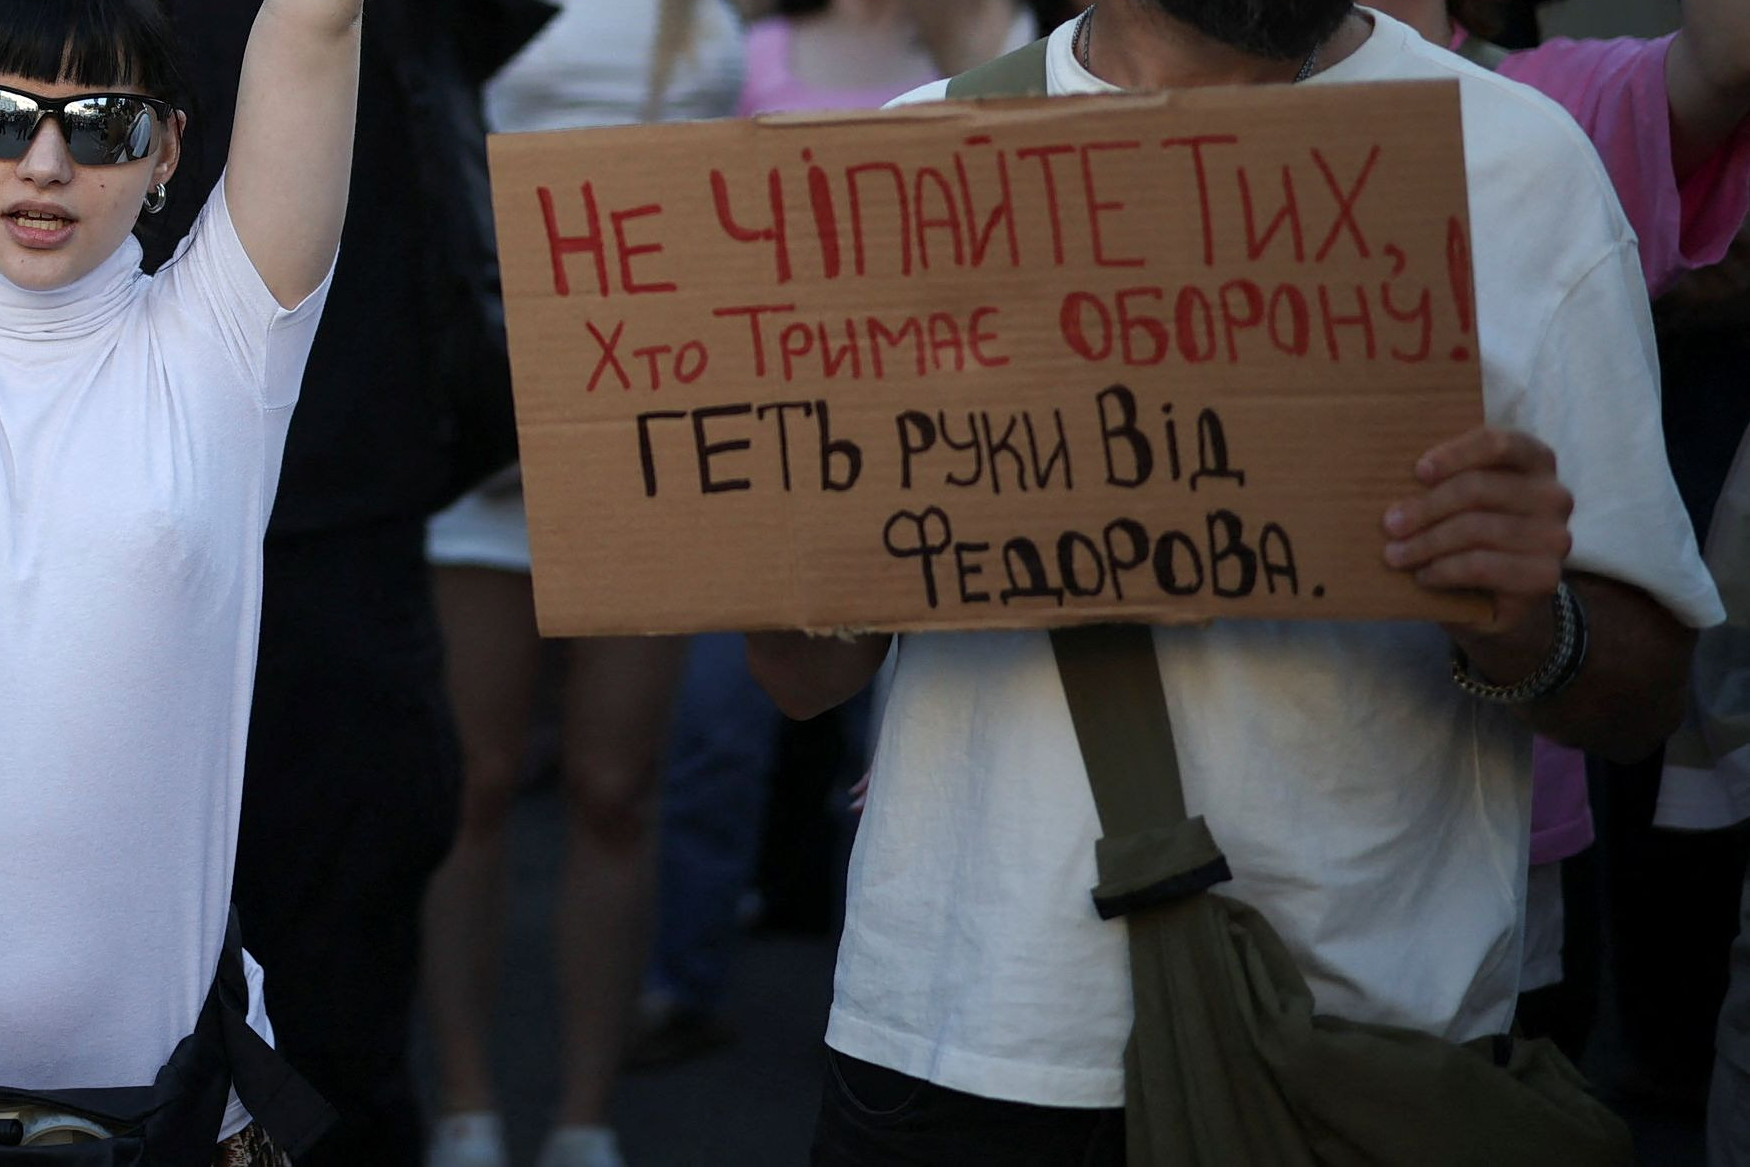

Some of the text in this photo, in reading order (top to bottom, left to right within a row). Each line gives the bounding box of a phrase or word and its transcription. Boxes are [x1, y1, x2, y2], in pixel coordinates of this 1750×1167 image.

[536, 181, 678, 298] НЕ
[636, 399, 863, 497] ГЕТЬ
[895, 407, 1071, 493] РУКИ
[882, 505, 1327, 609] ФЕДОРОВА.
